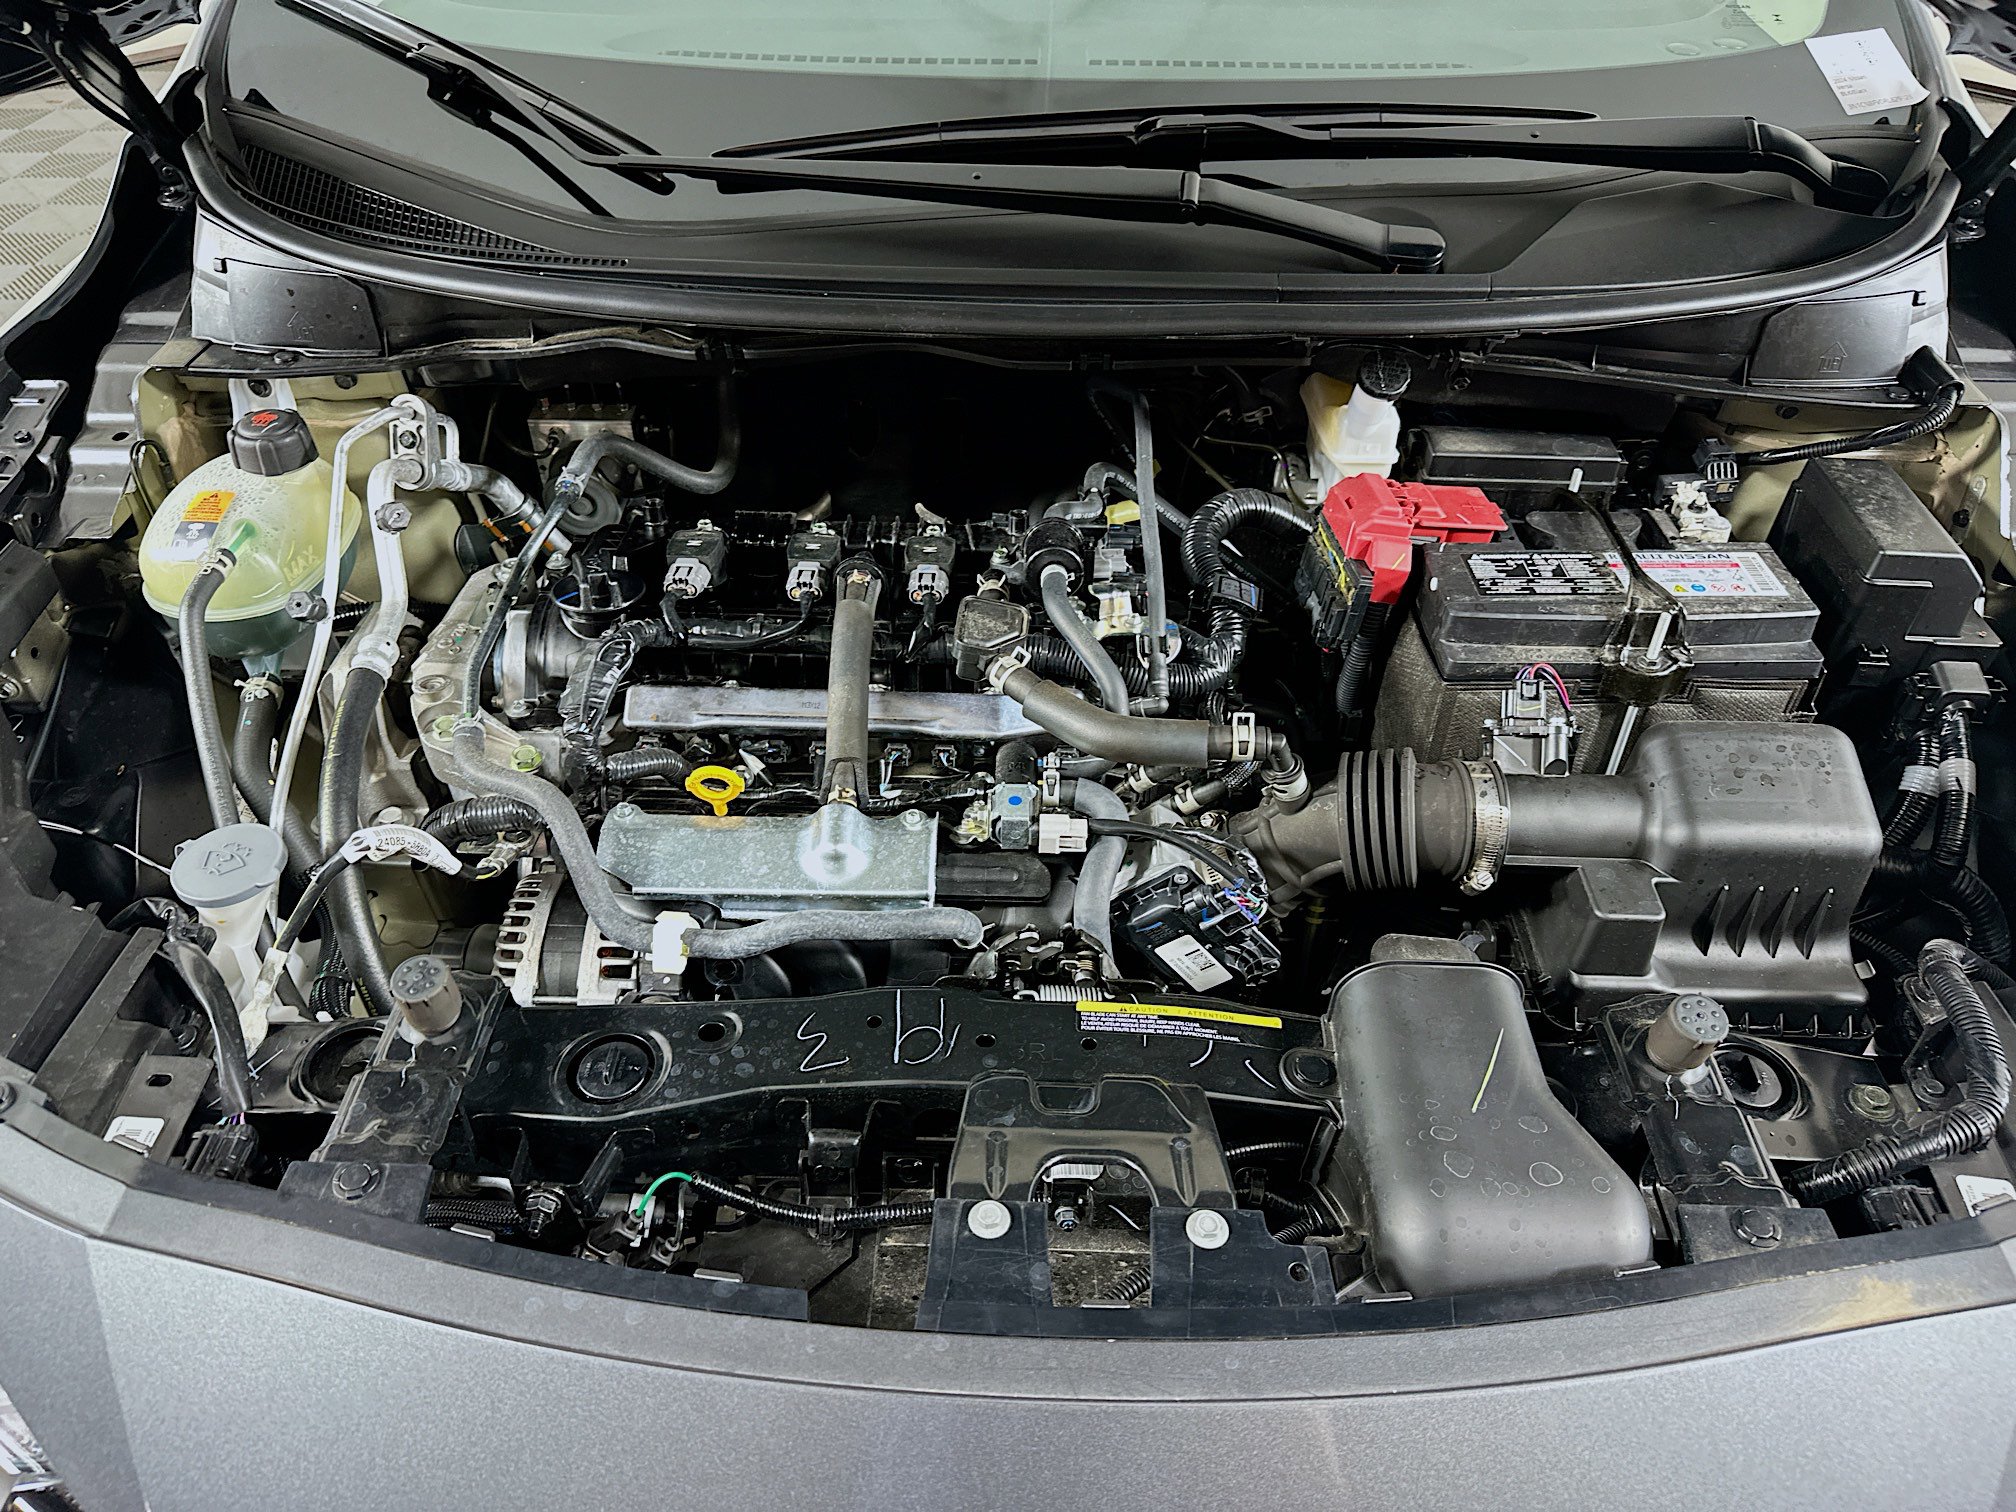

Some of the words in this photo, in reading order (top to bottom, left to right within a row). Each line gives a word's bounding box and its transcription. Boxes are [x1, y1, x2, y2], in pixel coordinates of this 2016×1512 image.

[283, 544, 319, 582] MAX
[1128, 1006, 1168, 1014] CAUTION
[1187, 1010, 1235, 1021] ATTENTION
